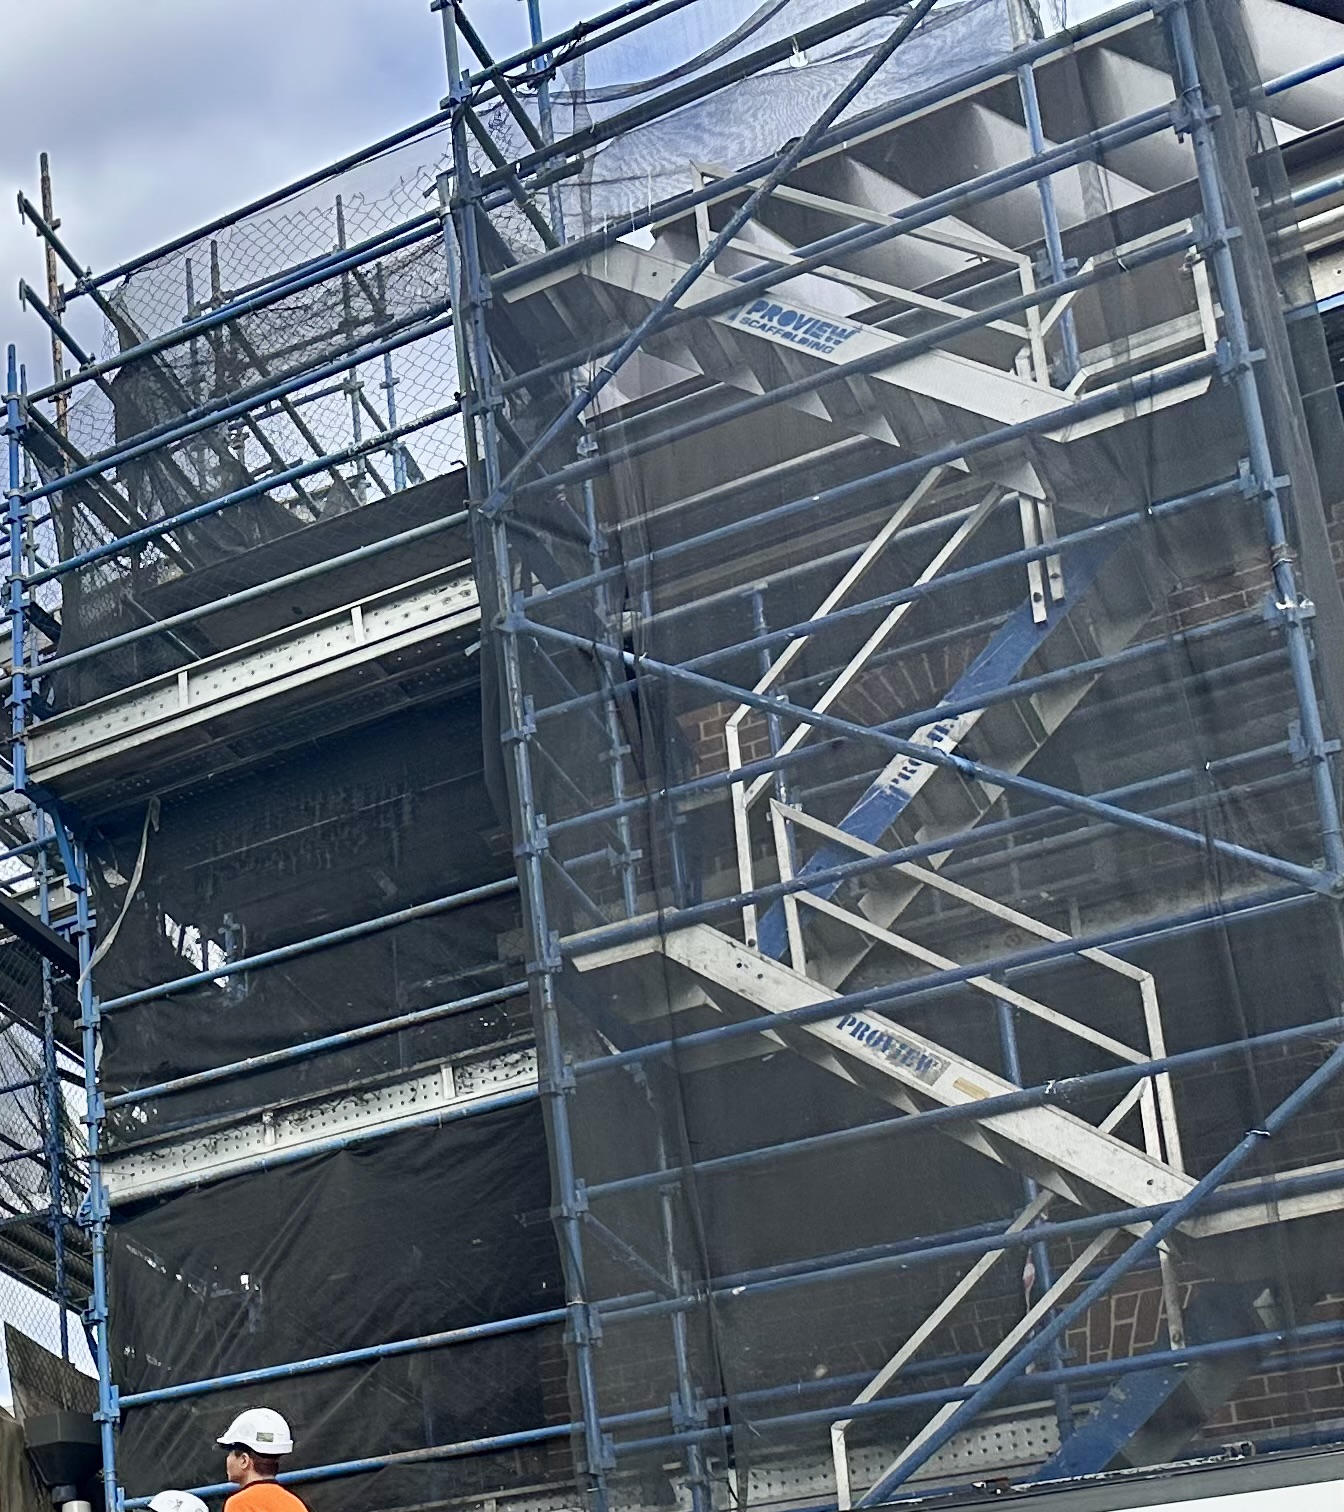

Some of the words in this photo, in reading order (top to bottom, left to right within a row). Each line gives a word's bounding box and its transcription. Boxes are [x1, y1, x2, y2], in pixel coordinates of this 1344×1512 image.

[739, 316, 836, 355] SCAFFOLDING
[746, 299, 859, 345] PROVIEW
[836, 1015, 938, 1075] PROVIEW
